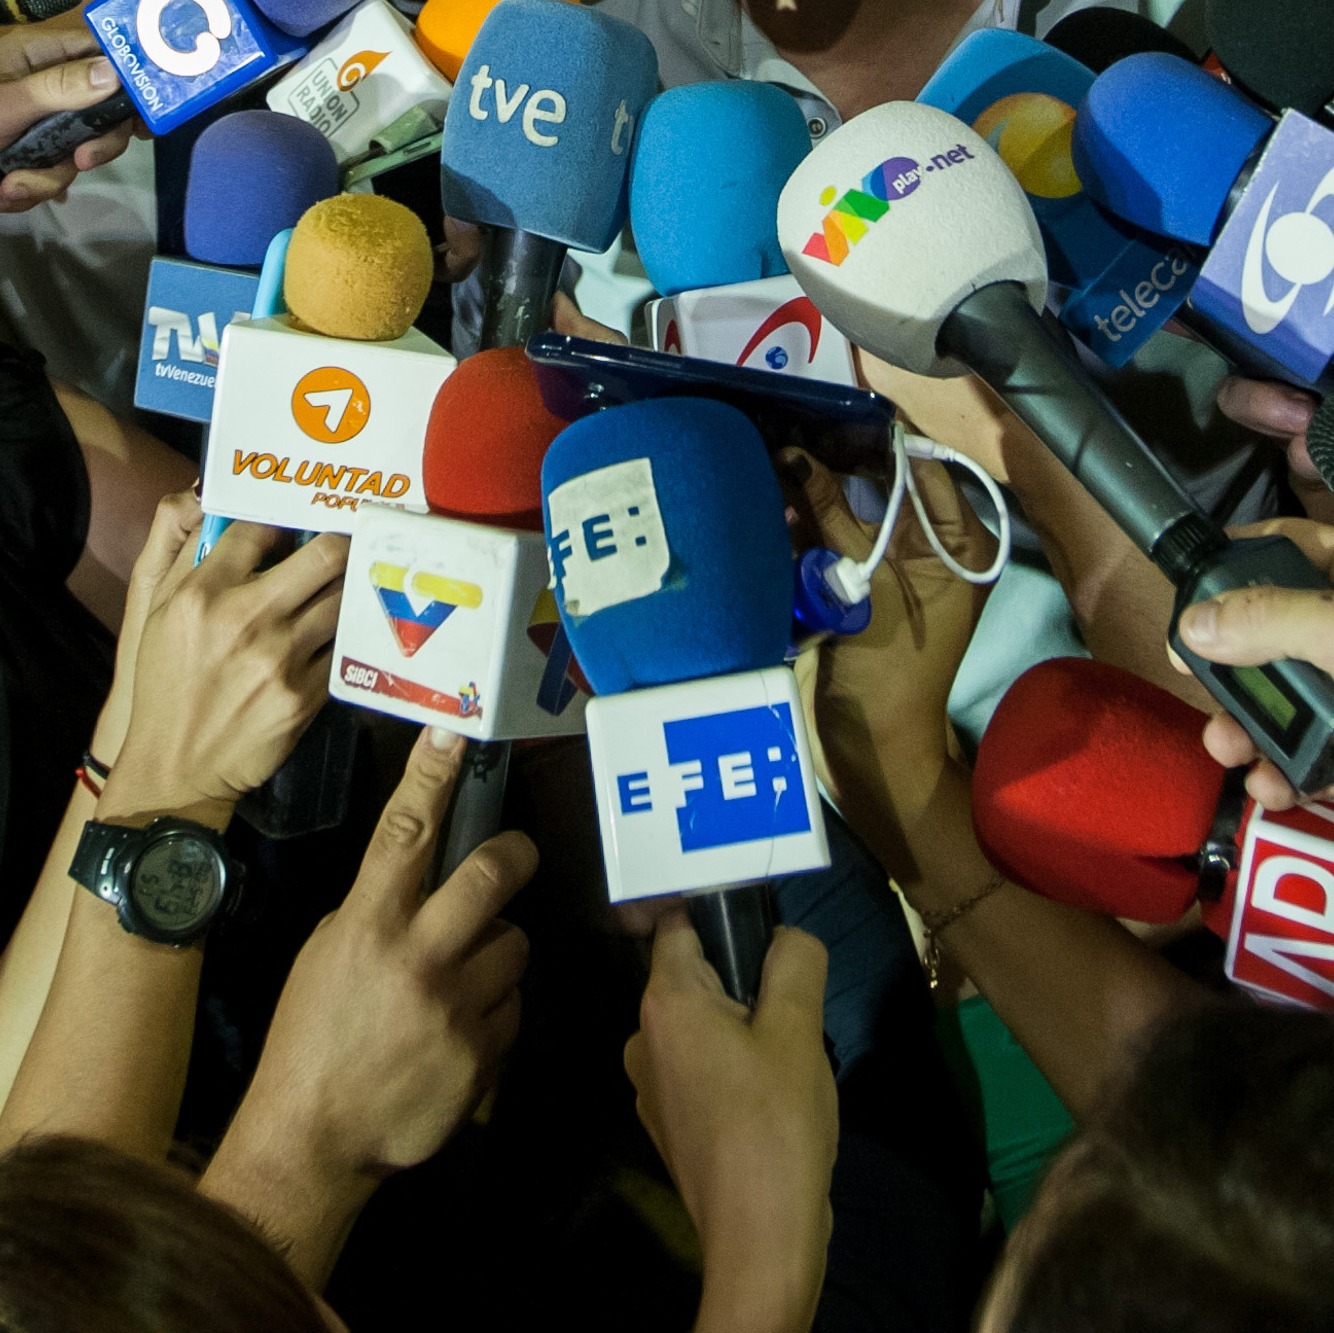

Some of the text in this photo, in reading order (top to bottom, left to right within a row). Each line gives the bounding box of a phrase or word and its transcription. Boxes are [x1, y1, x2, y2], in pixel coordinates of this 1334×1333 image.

[101, 17, 164, 112] GLOBOVISION
[297, 86, 332, 133] RADIO
[312, 70, 348, 122] UNION
[469, 64, 567, 148] tve
[1094, 246, 1198, 342] teleca
[155, 362, 216, 389] tvVenezue
[232, 449, 411, 499] VOLUNTAD
